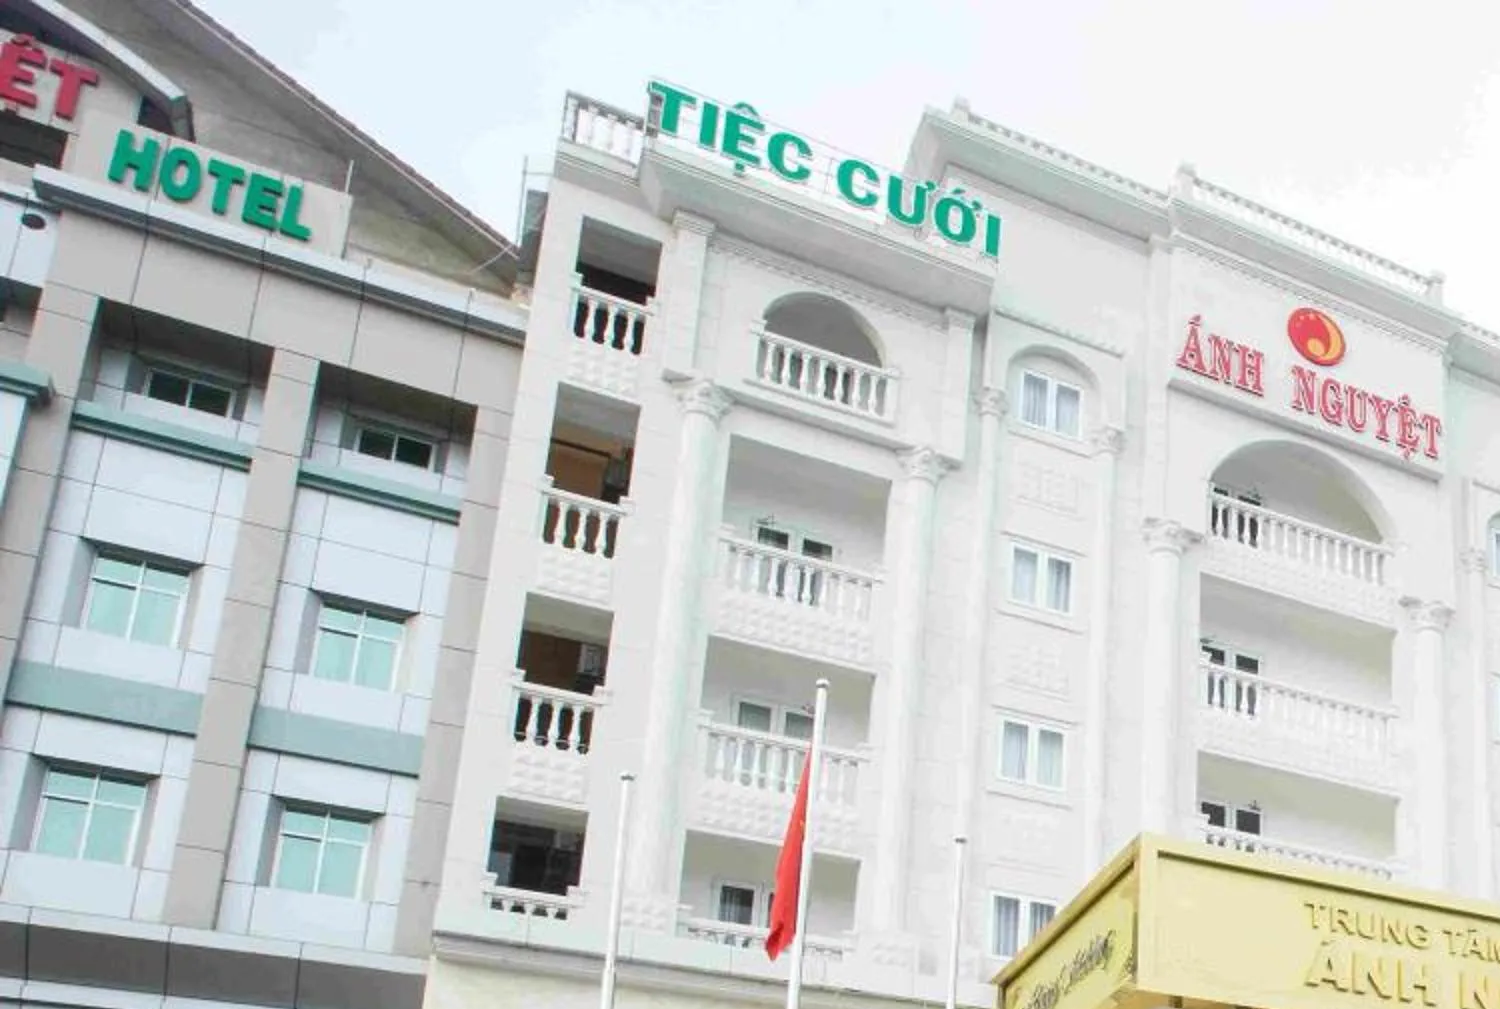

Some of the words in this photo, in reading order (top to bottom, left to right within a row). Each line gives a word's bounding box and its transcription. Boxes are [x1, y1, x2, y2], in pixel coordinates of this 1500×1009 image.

[107, 128, 312, 242] HOTEL
[648, 80, 813, 183] TIỆC
[836, 158, 1002, 258] CƯỚI
[1176, 314, 1265, 397] ÁNH
[1290, 364, 1443, 460] NGUYỆT
[1303, 901, 1432, 951] TRUNG
